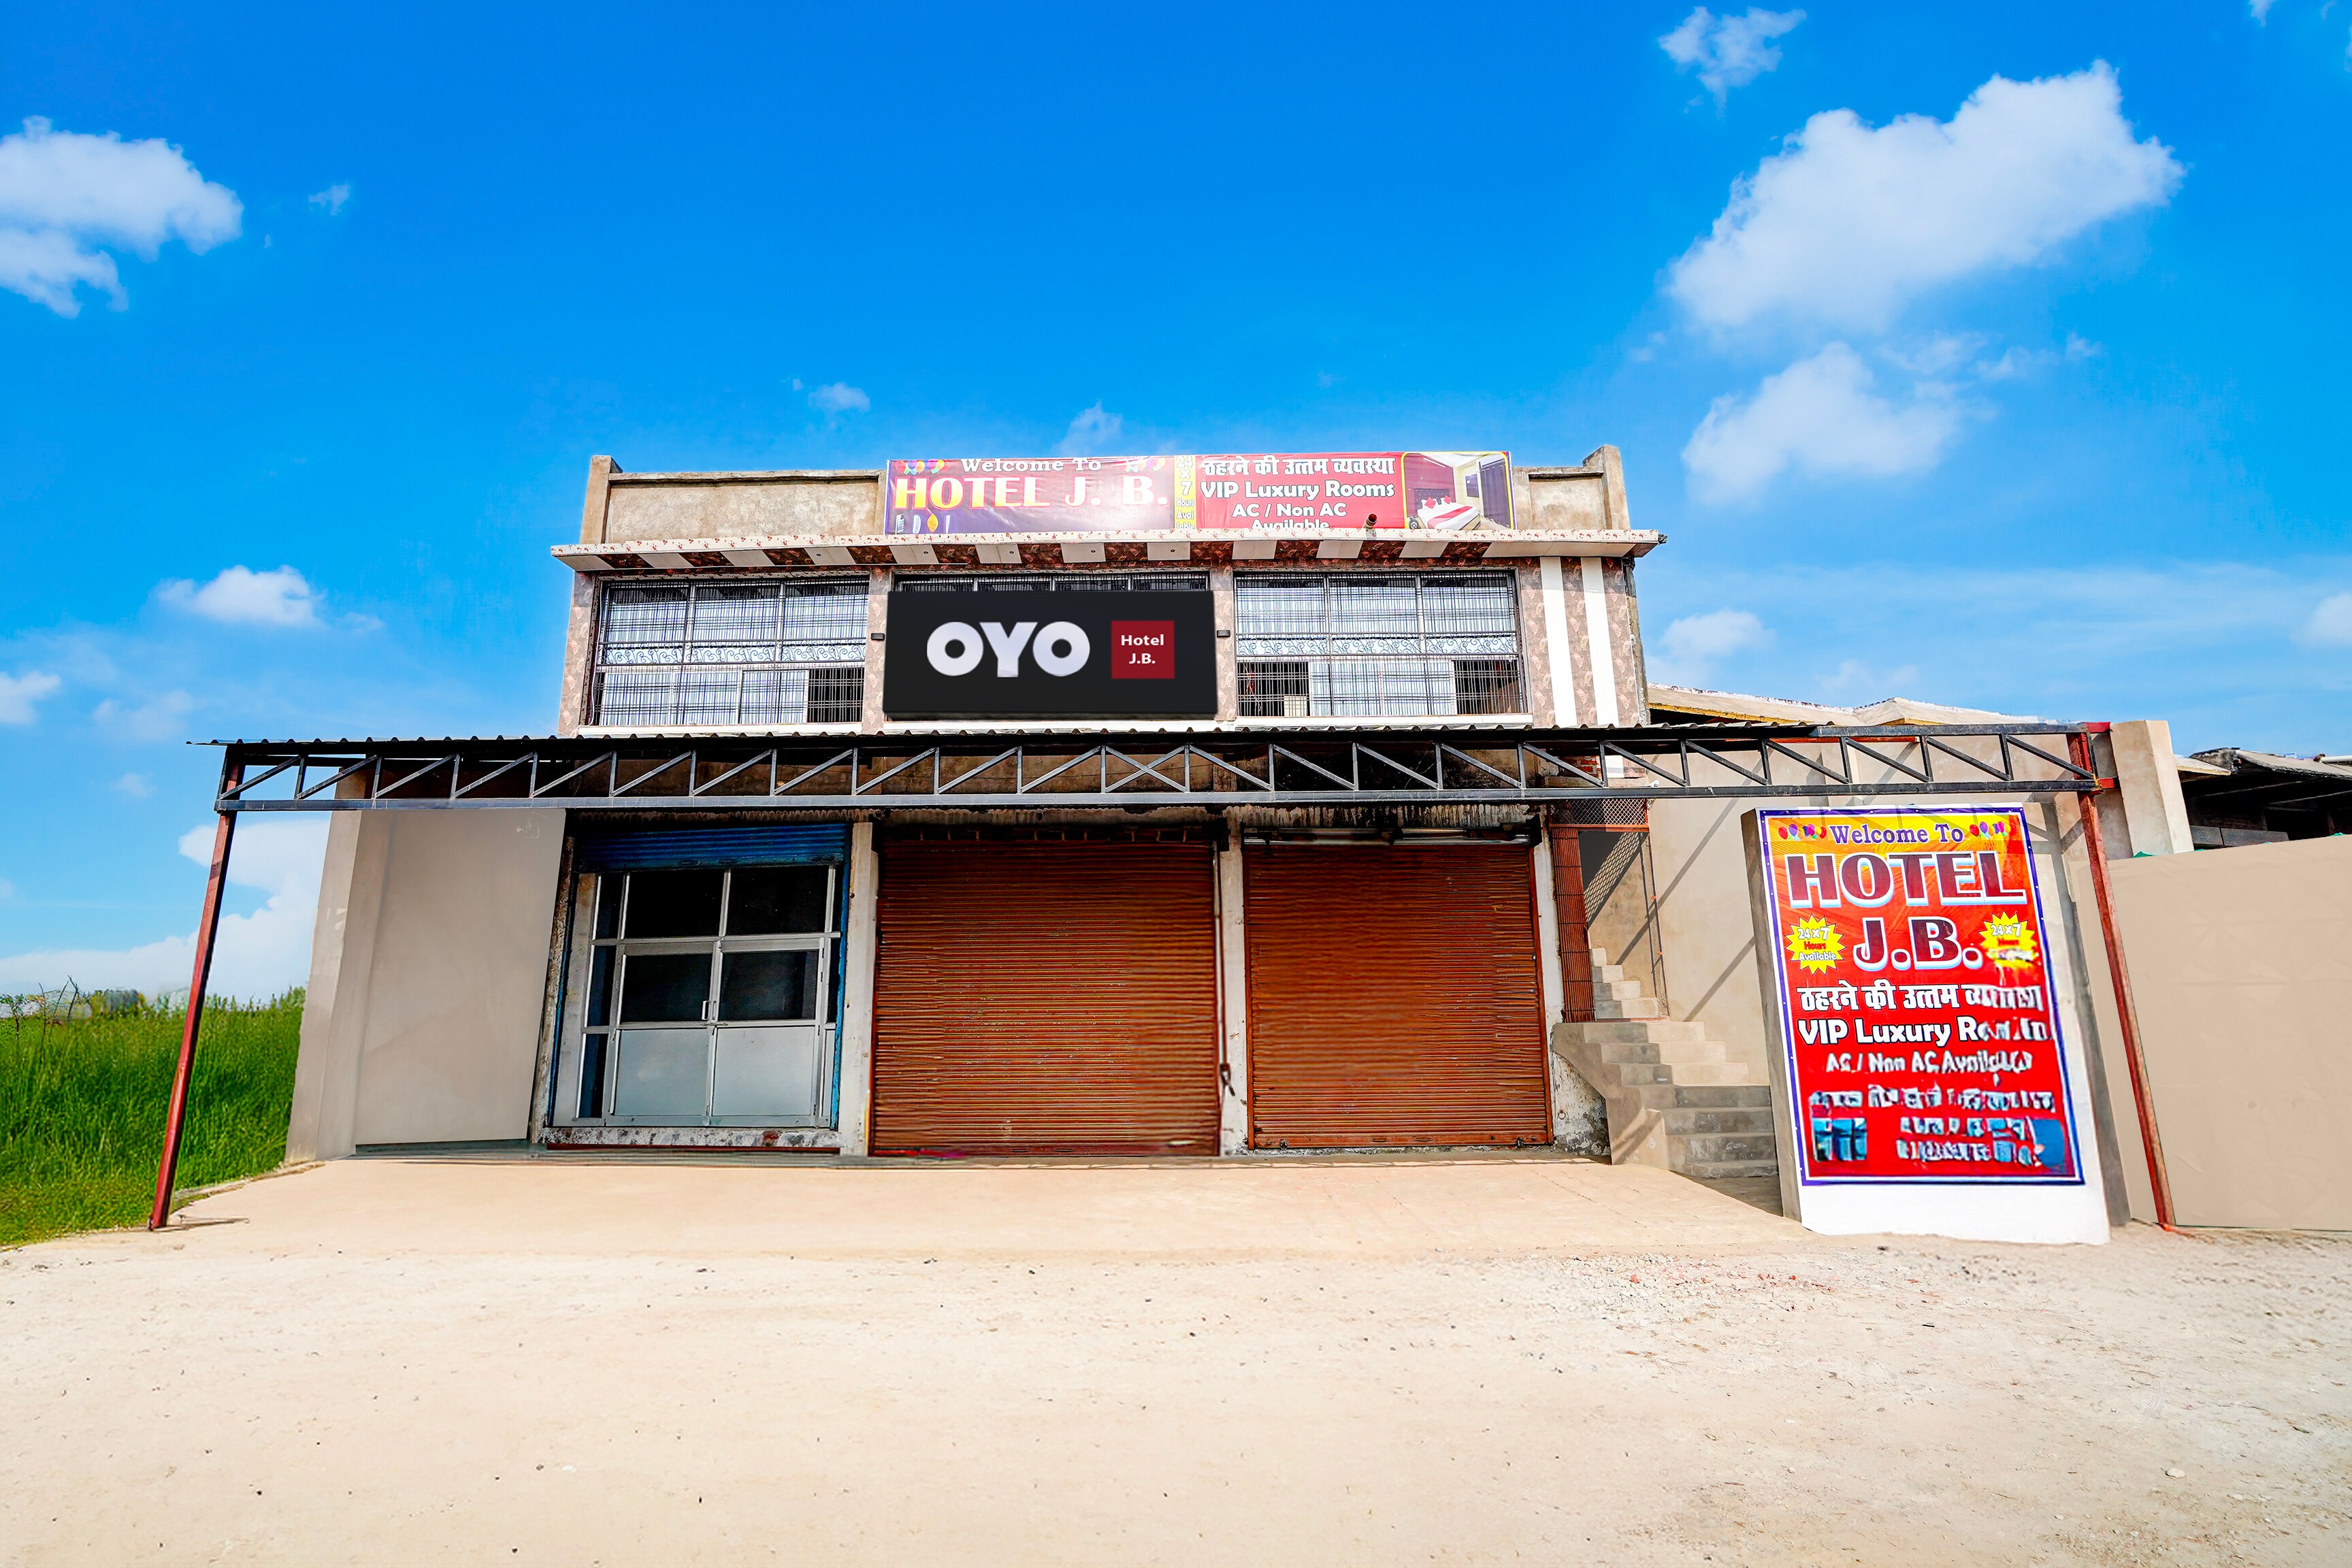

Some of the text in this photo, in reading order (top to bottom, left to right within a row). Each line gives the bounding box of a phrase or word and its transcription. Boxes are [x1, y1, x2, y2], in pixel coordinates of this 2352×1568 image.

[960, 456, 1102, 473] Welcome To
[1176, 455, 1194, 468] 24
[1203, 455, 1395, 476] ठहरने की उत्तम व्यवस्था
[893, 475, 1051, 510] HOTEL
[1180, 481, 1192, 495] 7
[1200, 480, 1395, 501] VIP Luxury Rooms
[1176, 497, 1195, 508] Hours
[1231, 503, 1260, 517] AC
[1276, 503, 1315, 517] Non
[1319, 502, 1348, 517] AC
[927, 621, 1090, 678] OYO
[1120, 634, 1164, 647] Hotel
[1128, 653, 1156, 665] J.B.
[1829, 822, 1965, 845] Welcome To
[1784, 851, 2027, 909] HOTEL
[1803, 941, 1827, 950] Hours
[1853, 916, 1983, 971] J.B.
[1799, 951, 1837, 961] Available
[1797, 980, 1859, 1011] ठहरने
[1861, 979, 1897, 1009] की
[1899, 984, 1960, 1009] उत्तम
[1798, 1019, 1848, 1045] VIP
[1855, 1019, 1951, 1047] Luxury
